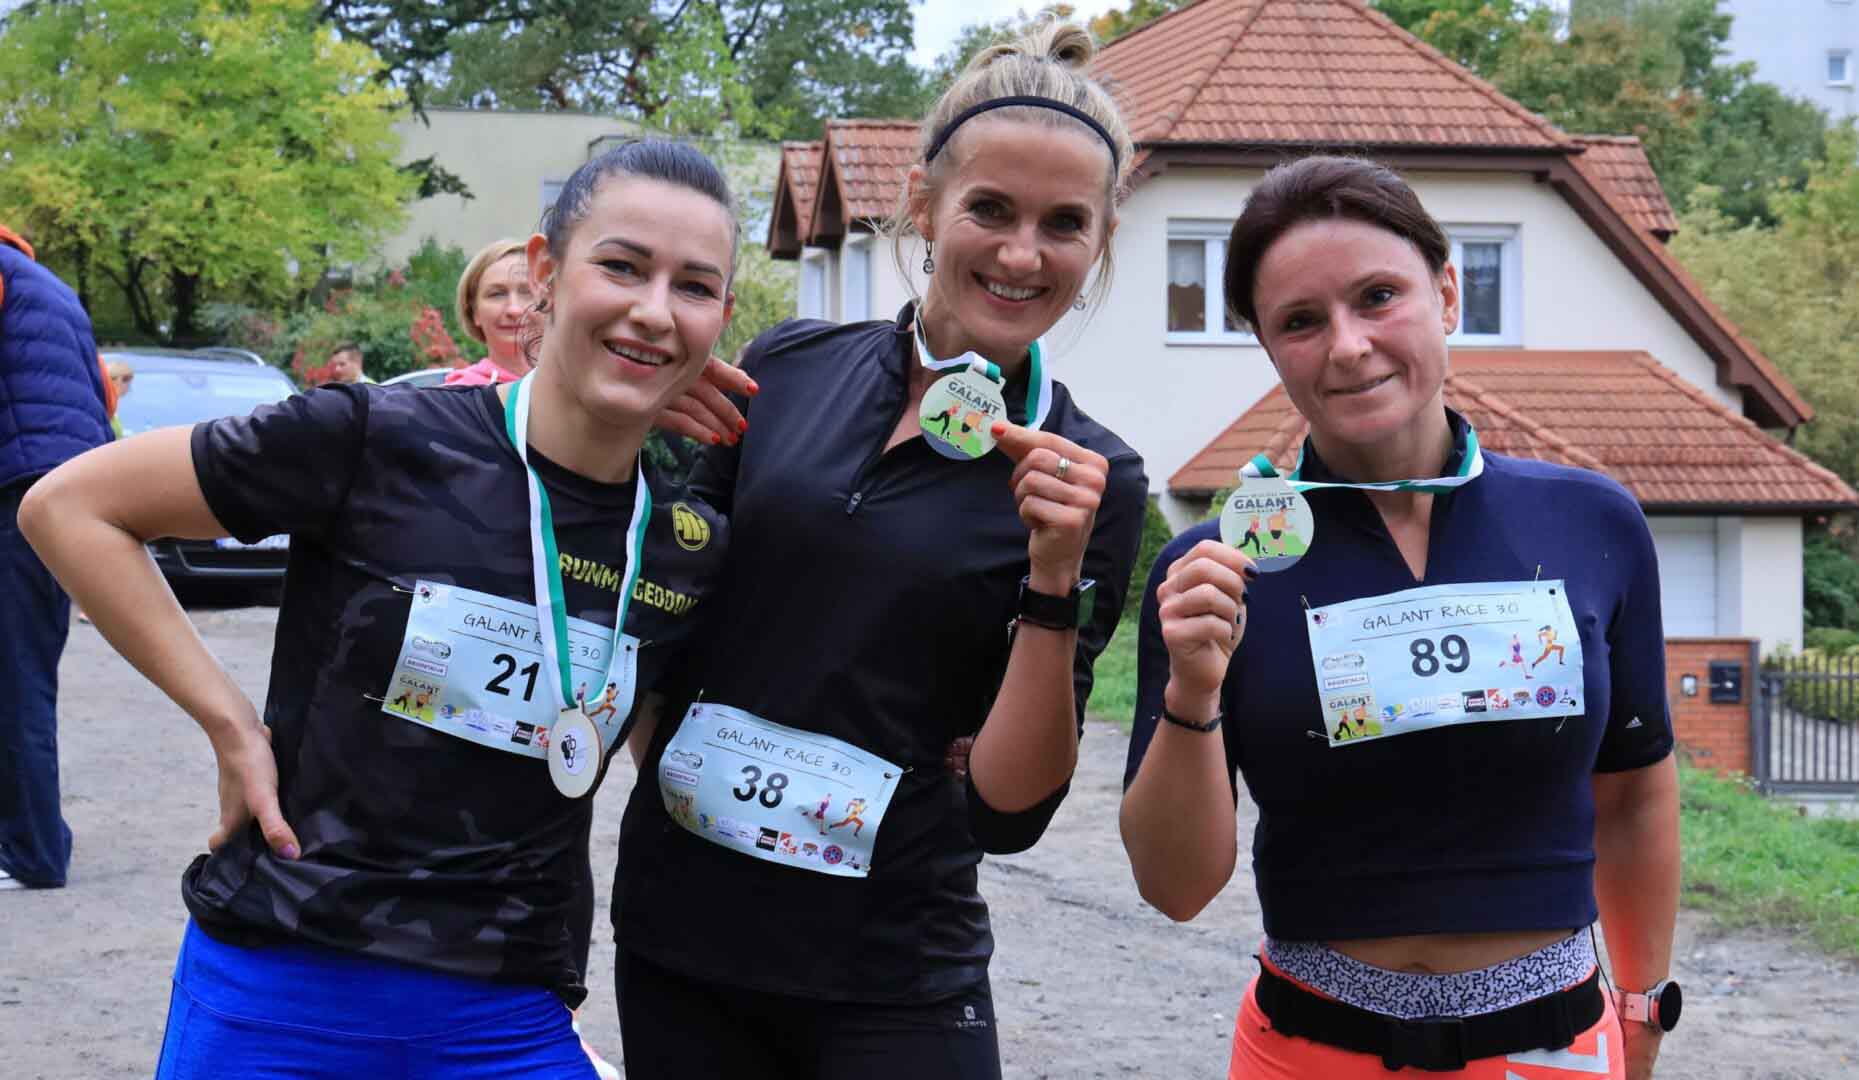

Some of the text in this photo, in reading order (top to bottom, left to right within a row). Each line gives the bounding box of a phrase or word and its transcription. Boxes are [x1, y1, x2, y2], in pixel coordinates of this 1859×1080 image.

[948, 381, 1000, 415] GALANT
[1234, 496, 1295, 510] GALANT
[559, 552, 698, 615] RUNMGEDDON
[463, 613, 530, 640] GALANT
[533, 631, 575, 654] RE
[1363, 608, 1433, 630] GALANT
[1441, 603, 1488, 616] RACE
[1409, 634, 1471, 677] 89
[485, 653, 540, 702] 21
[1329, 696, 1371, 709] GALANT
[717, 727, 778, 753] GALANT
[783, 747, 825, 768] RACE
[733, 765, 789, 808] 38
